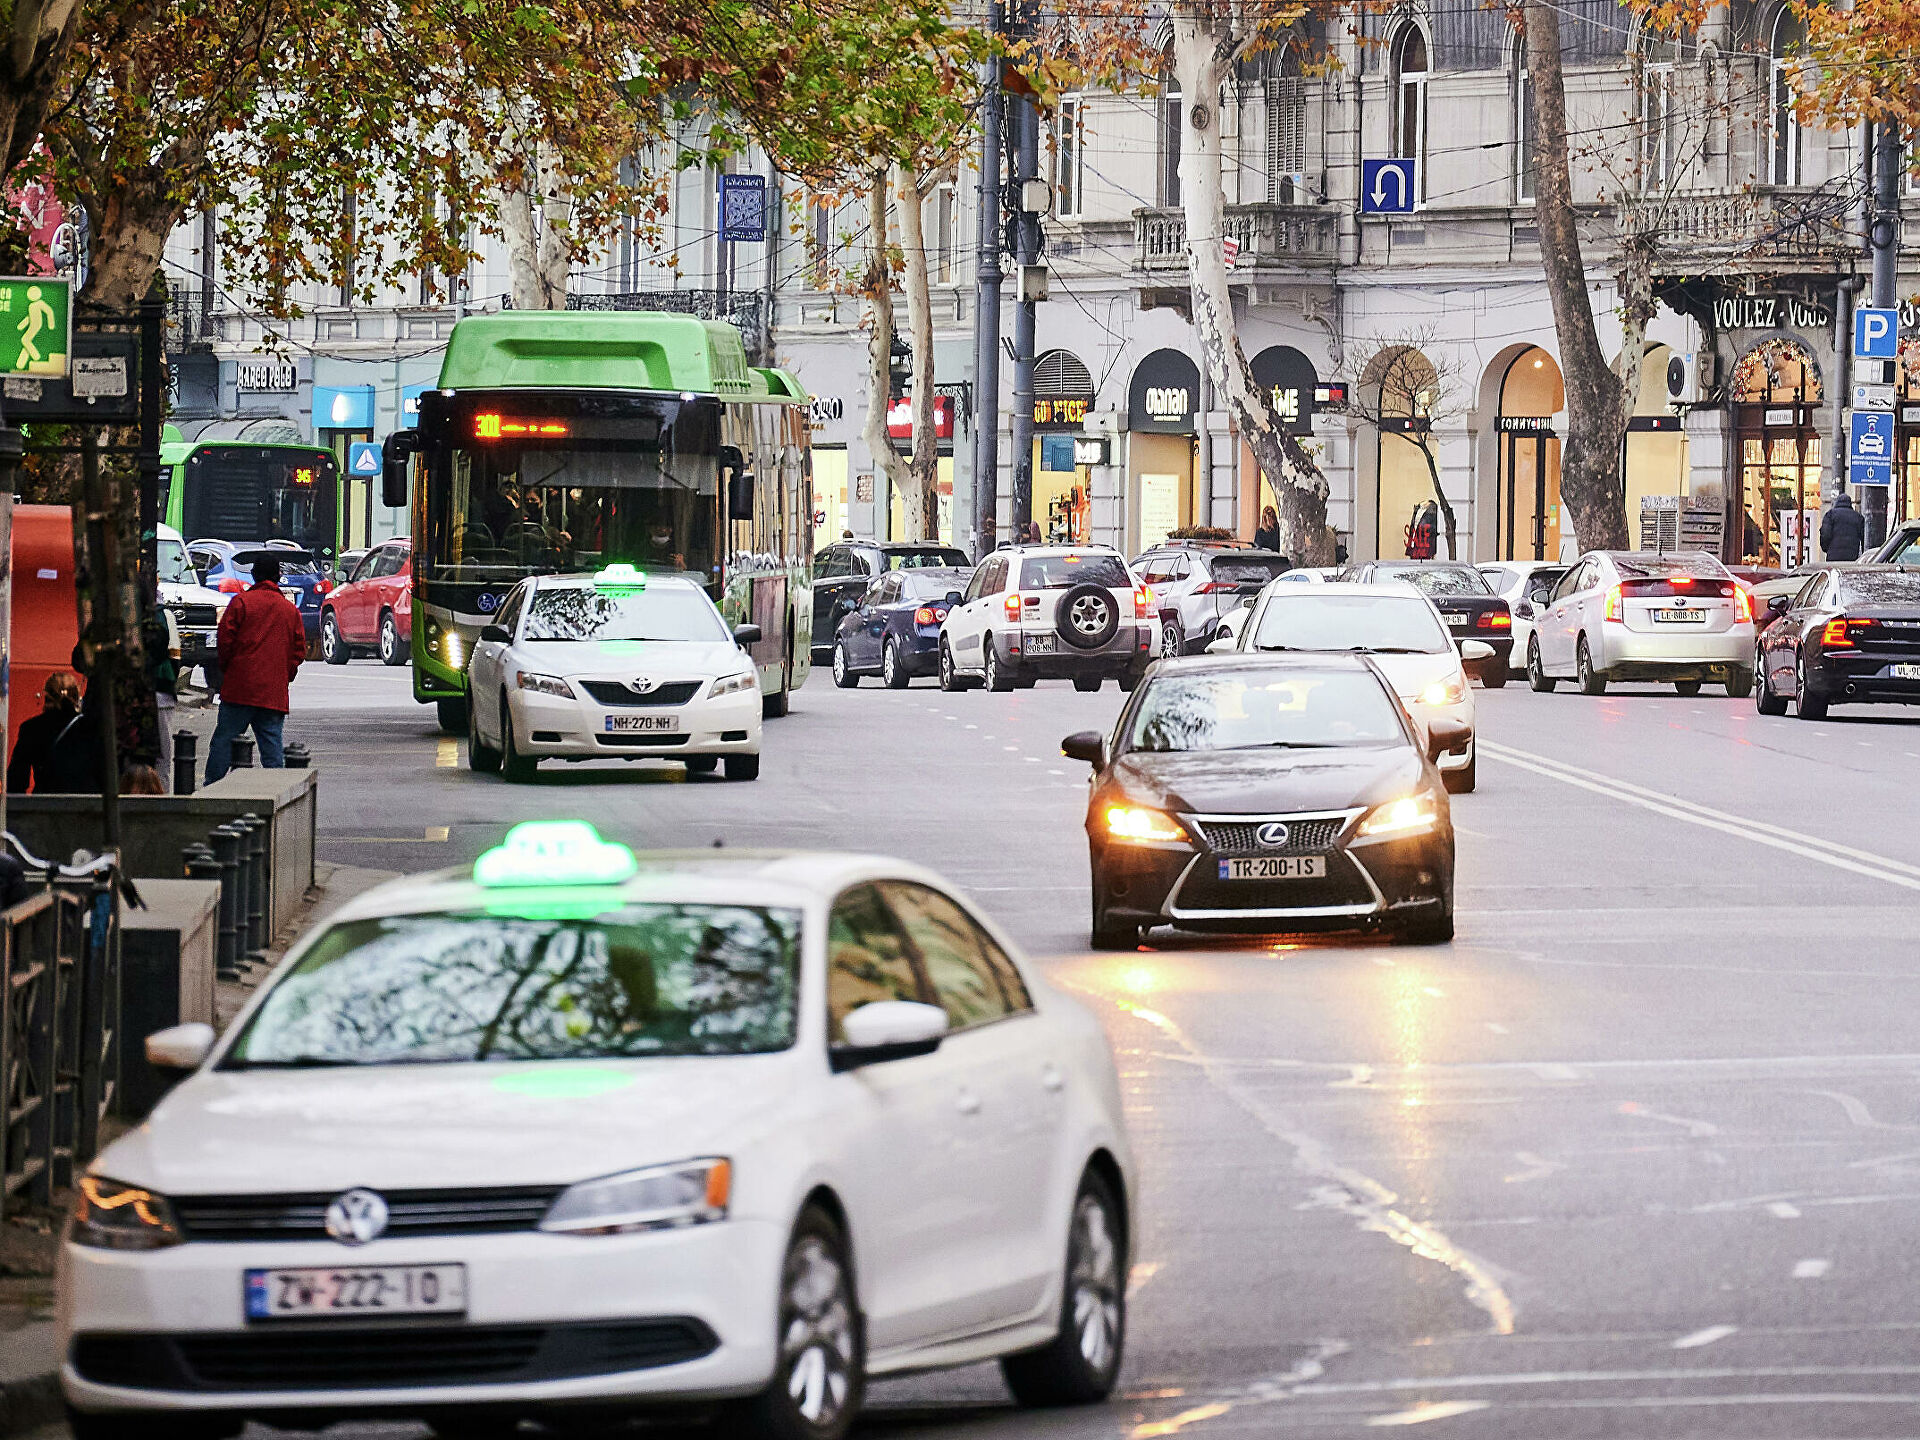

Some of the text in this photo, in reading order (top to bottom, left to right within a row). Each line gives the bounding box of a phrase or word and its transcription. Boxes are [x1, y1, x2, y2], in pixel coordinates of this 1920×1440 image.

[1713, 299, 1776, 328] VOULEZ
[1864, 313, 1889, 352] P
[236, 366, 292, 389] MARCO POLO
[1500, 417, 1531, 430] TOMMY
[295, 468, 312, 483] 345
[1403, 523, 1431, 549] SALE
[614, 717, 670, 729] NH-270-NH
[1233, 858, 1314, 876] TR-200-IS
